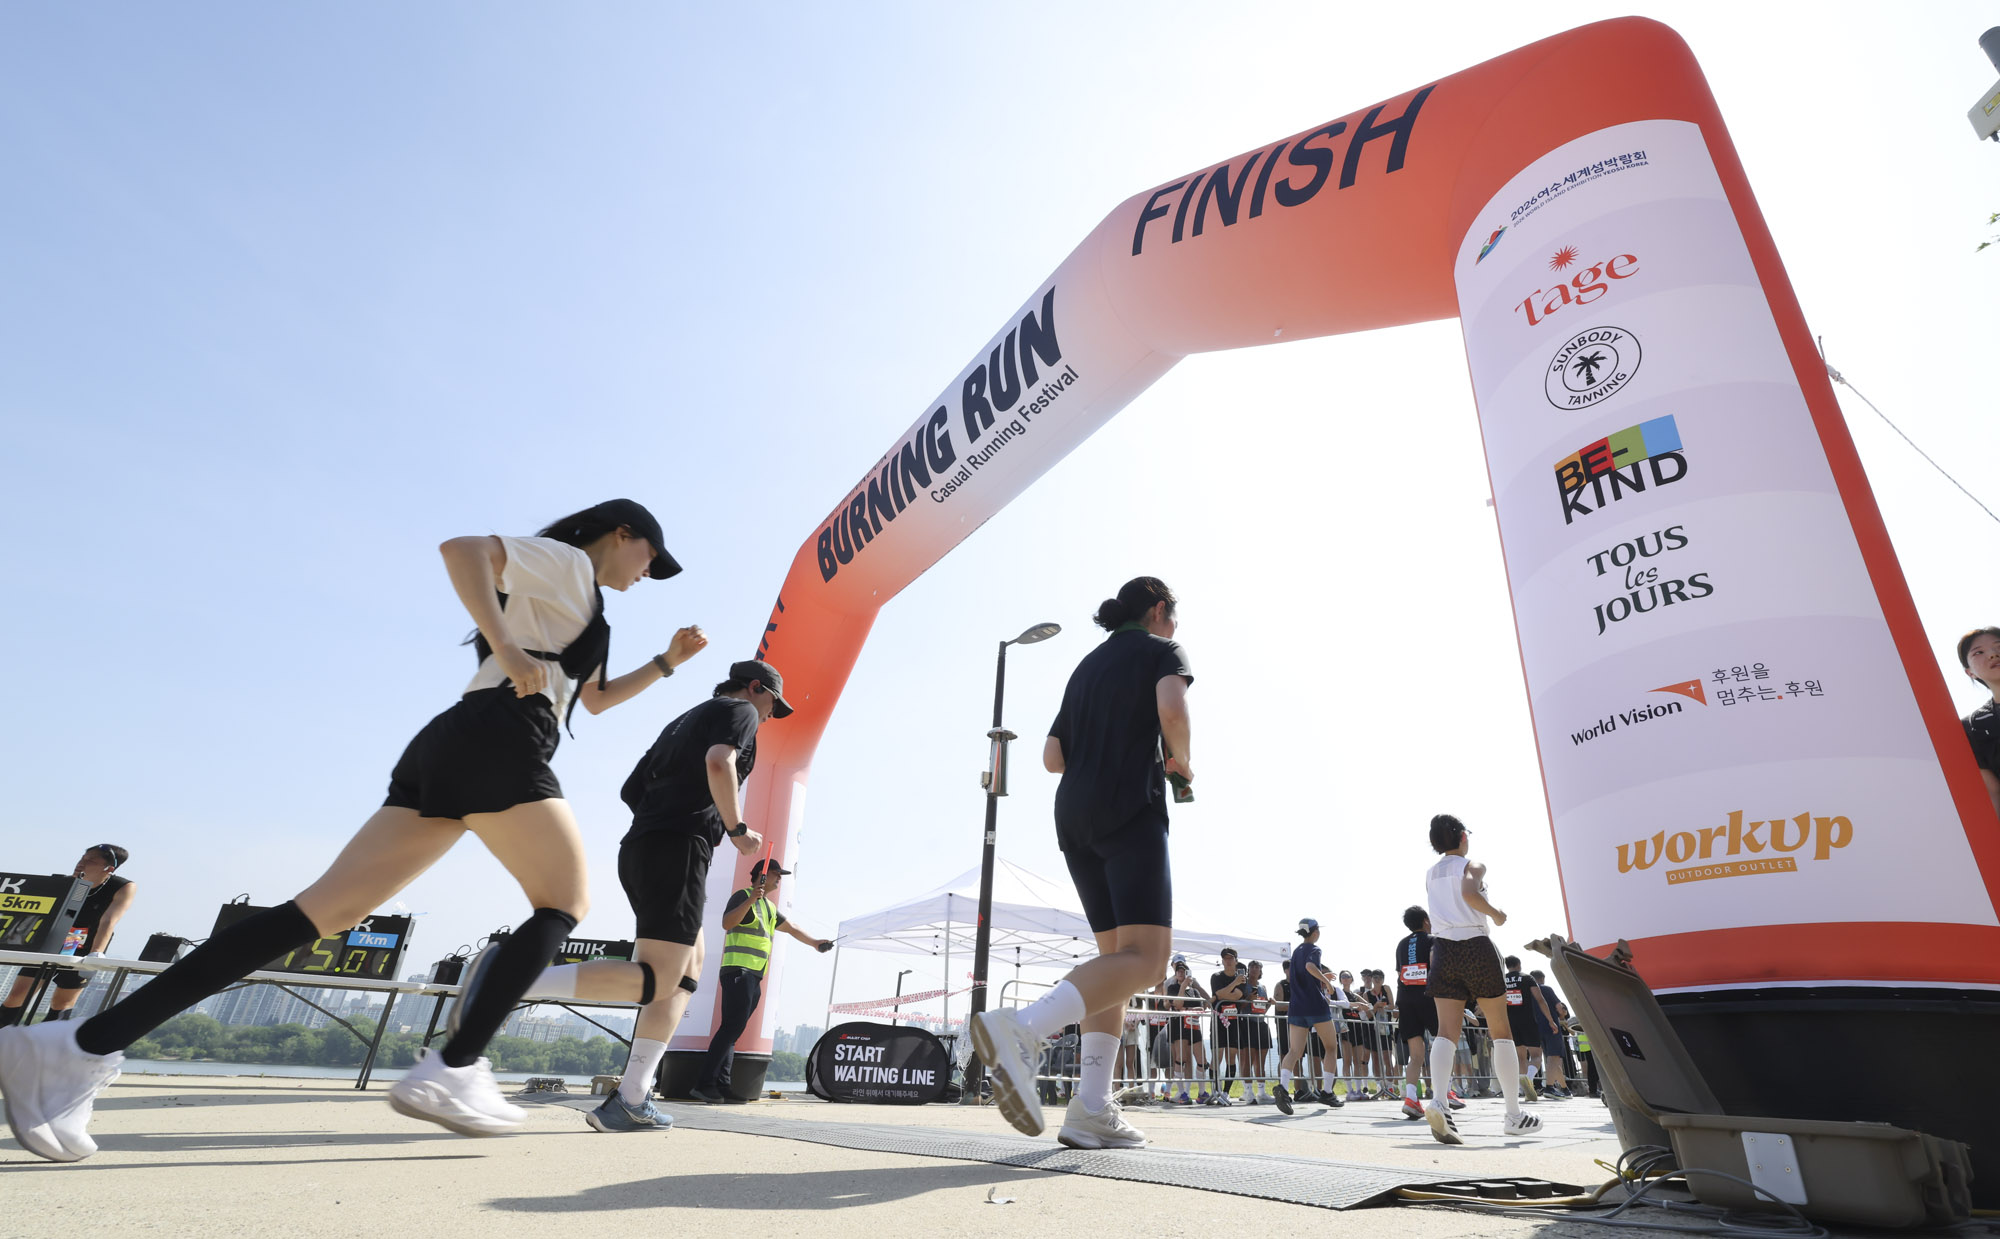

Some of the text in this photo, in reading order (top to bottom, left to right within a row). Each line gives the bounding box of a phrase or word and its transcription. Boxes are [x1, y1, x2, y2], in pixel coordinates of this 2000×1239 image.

[1132, 84, 1438, 256] FINISH
[1525, 202, 1545, 217] WORLD
[1545, 189, 1566, 204] ISLAND
[1567, 174, 1602, 192] EXHIBITION
[1603, 166, 1625, 175] YEOSU
[1626, 161, 1649, 169] KOREA
[1553, 330, 1623, 372] SUNBODY
[1567, 371, 1627, 406] TANNING
[817, 405, 957, 583] BURNING
[962, 284, 1062, 444] RUN
[931, 464, 973, 503] Casual
[966, 419, 1026, 471] Running
[1017, 364, 1080, 423] Festival
[1562, 451, 1688, 525] KIND
[1587, 525, 1689, 577] TOUS
[1625, 565, 1659, 590] les
[1593, 572, 1714, 636] JOURS
[1712, 662, 1770, 685] 후원을
[1571, 700, 1683, 746] World Vision
[1669, 859, 1793, 882] OUTDOOR OUTLET
[2, 896, 41, 910] 5km
[358, 933, 388, 946] 7km
[834, 1043, 885, 1063] START
[834, 1065, 935, 1086] WAITING LINE
